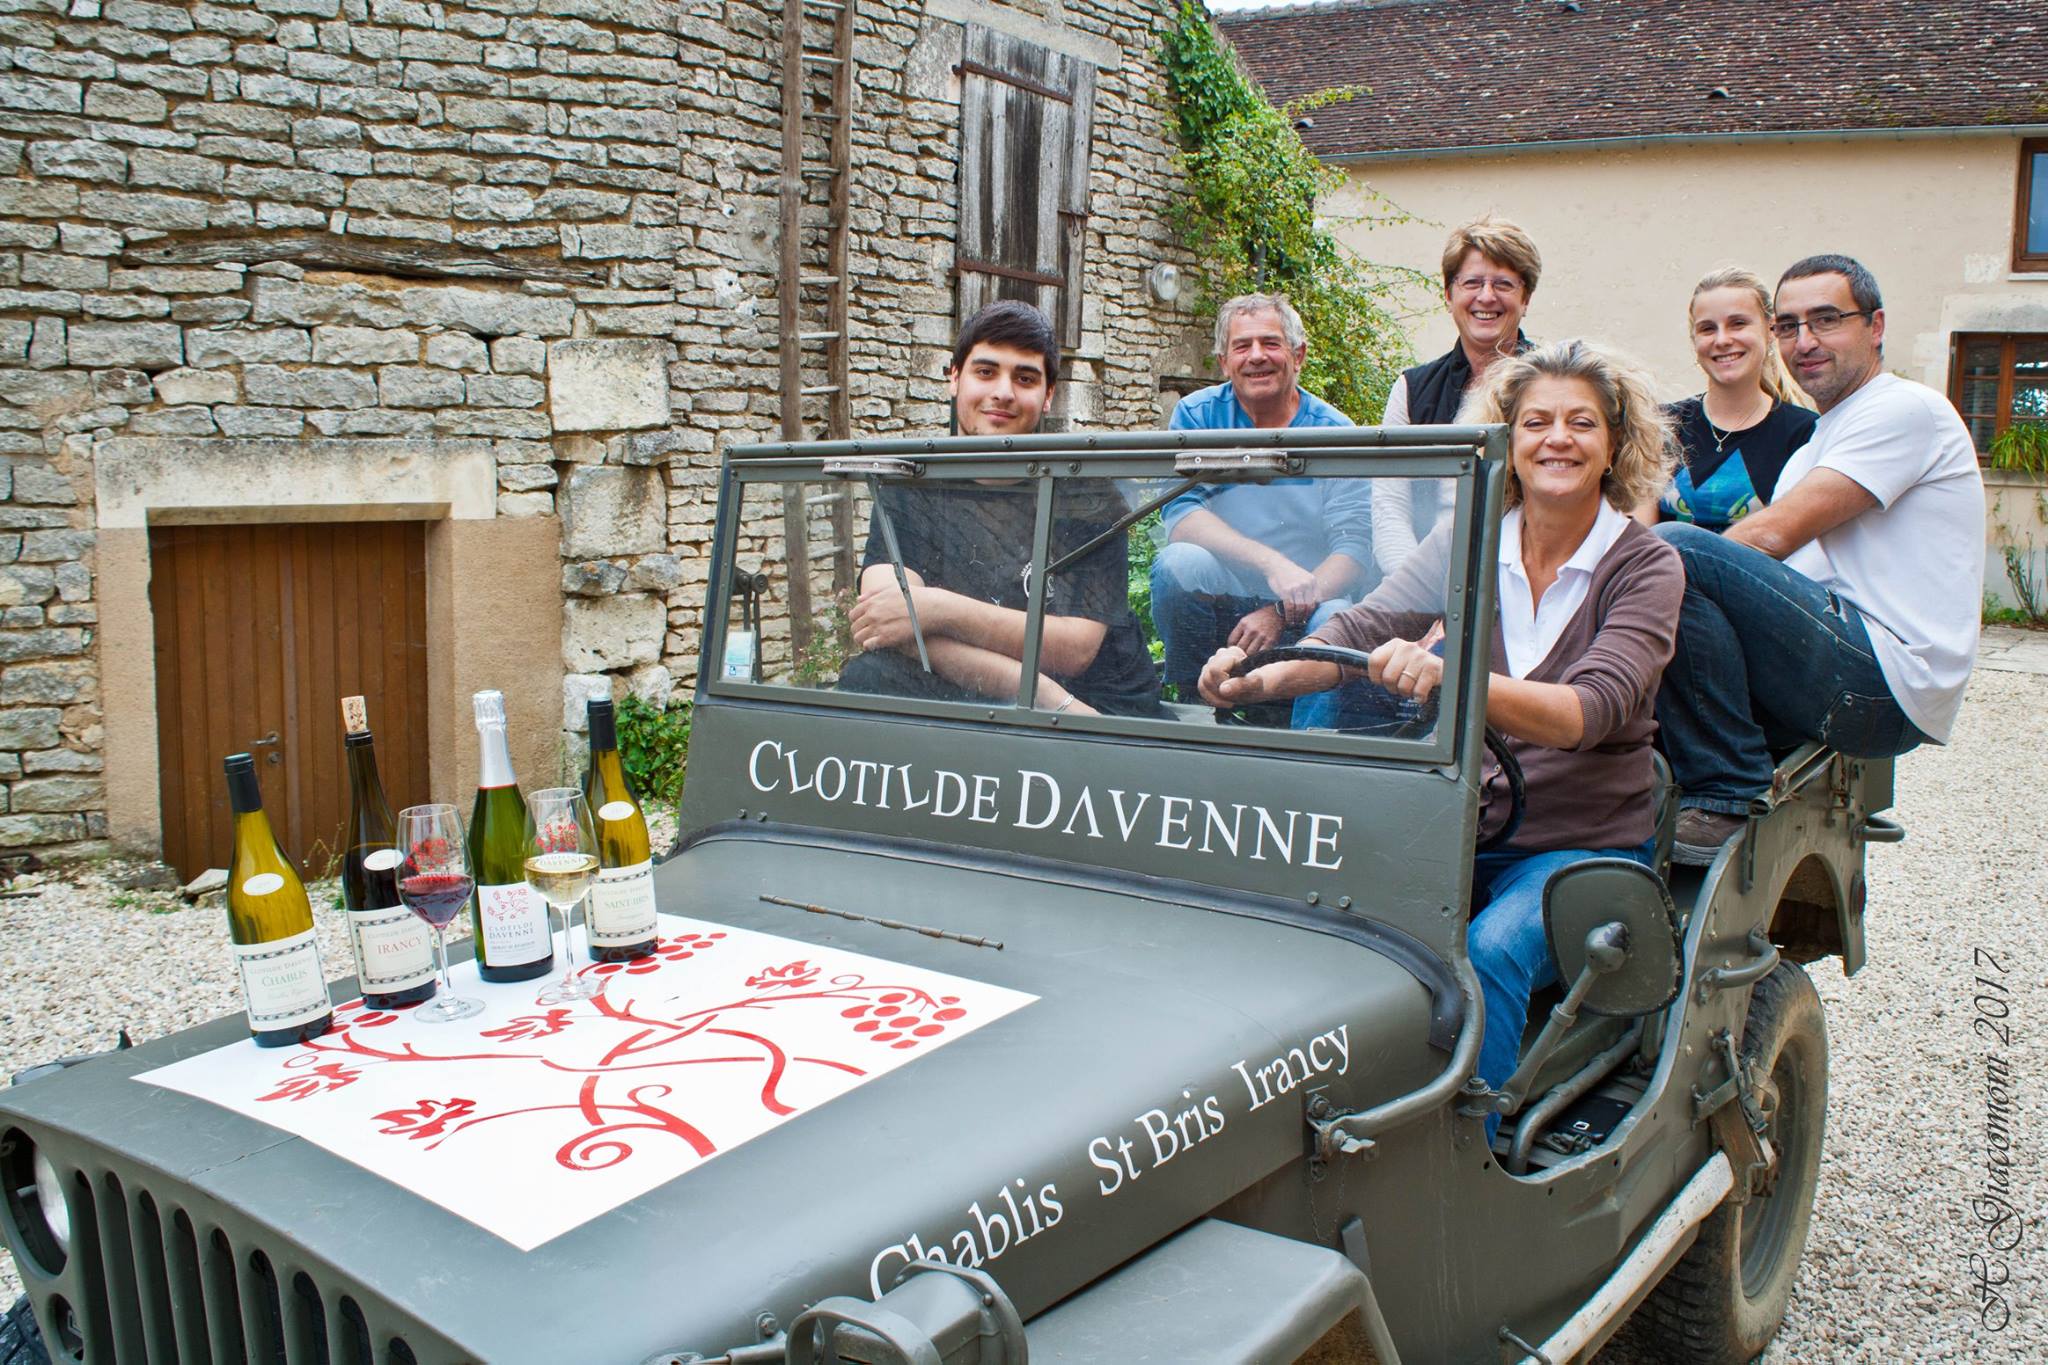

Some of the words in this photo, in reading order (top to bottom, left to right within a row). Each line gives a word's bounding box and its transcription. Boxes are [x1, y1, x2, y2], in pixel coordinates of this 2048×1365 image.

[748, 739, 1001, 824] CLOTILDE
[1012, 769, 1344, 870] DAVENNE
[261, 968, 309, 988] CHABLIS
[376, 935, 424, 955] IRANCY
[1087, 1136, 1142, 1197] St
[1135, 1090, 1226, 1168] Bris
[1230, 1024, 1352, 1113] Irancy
